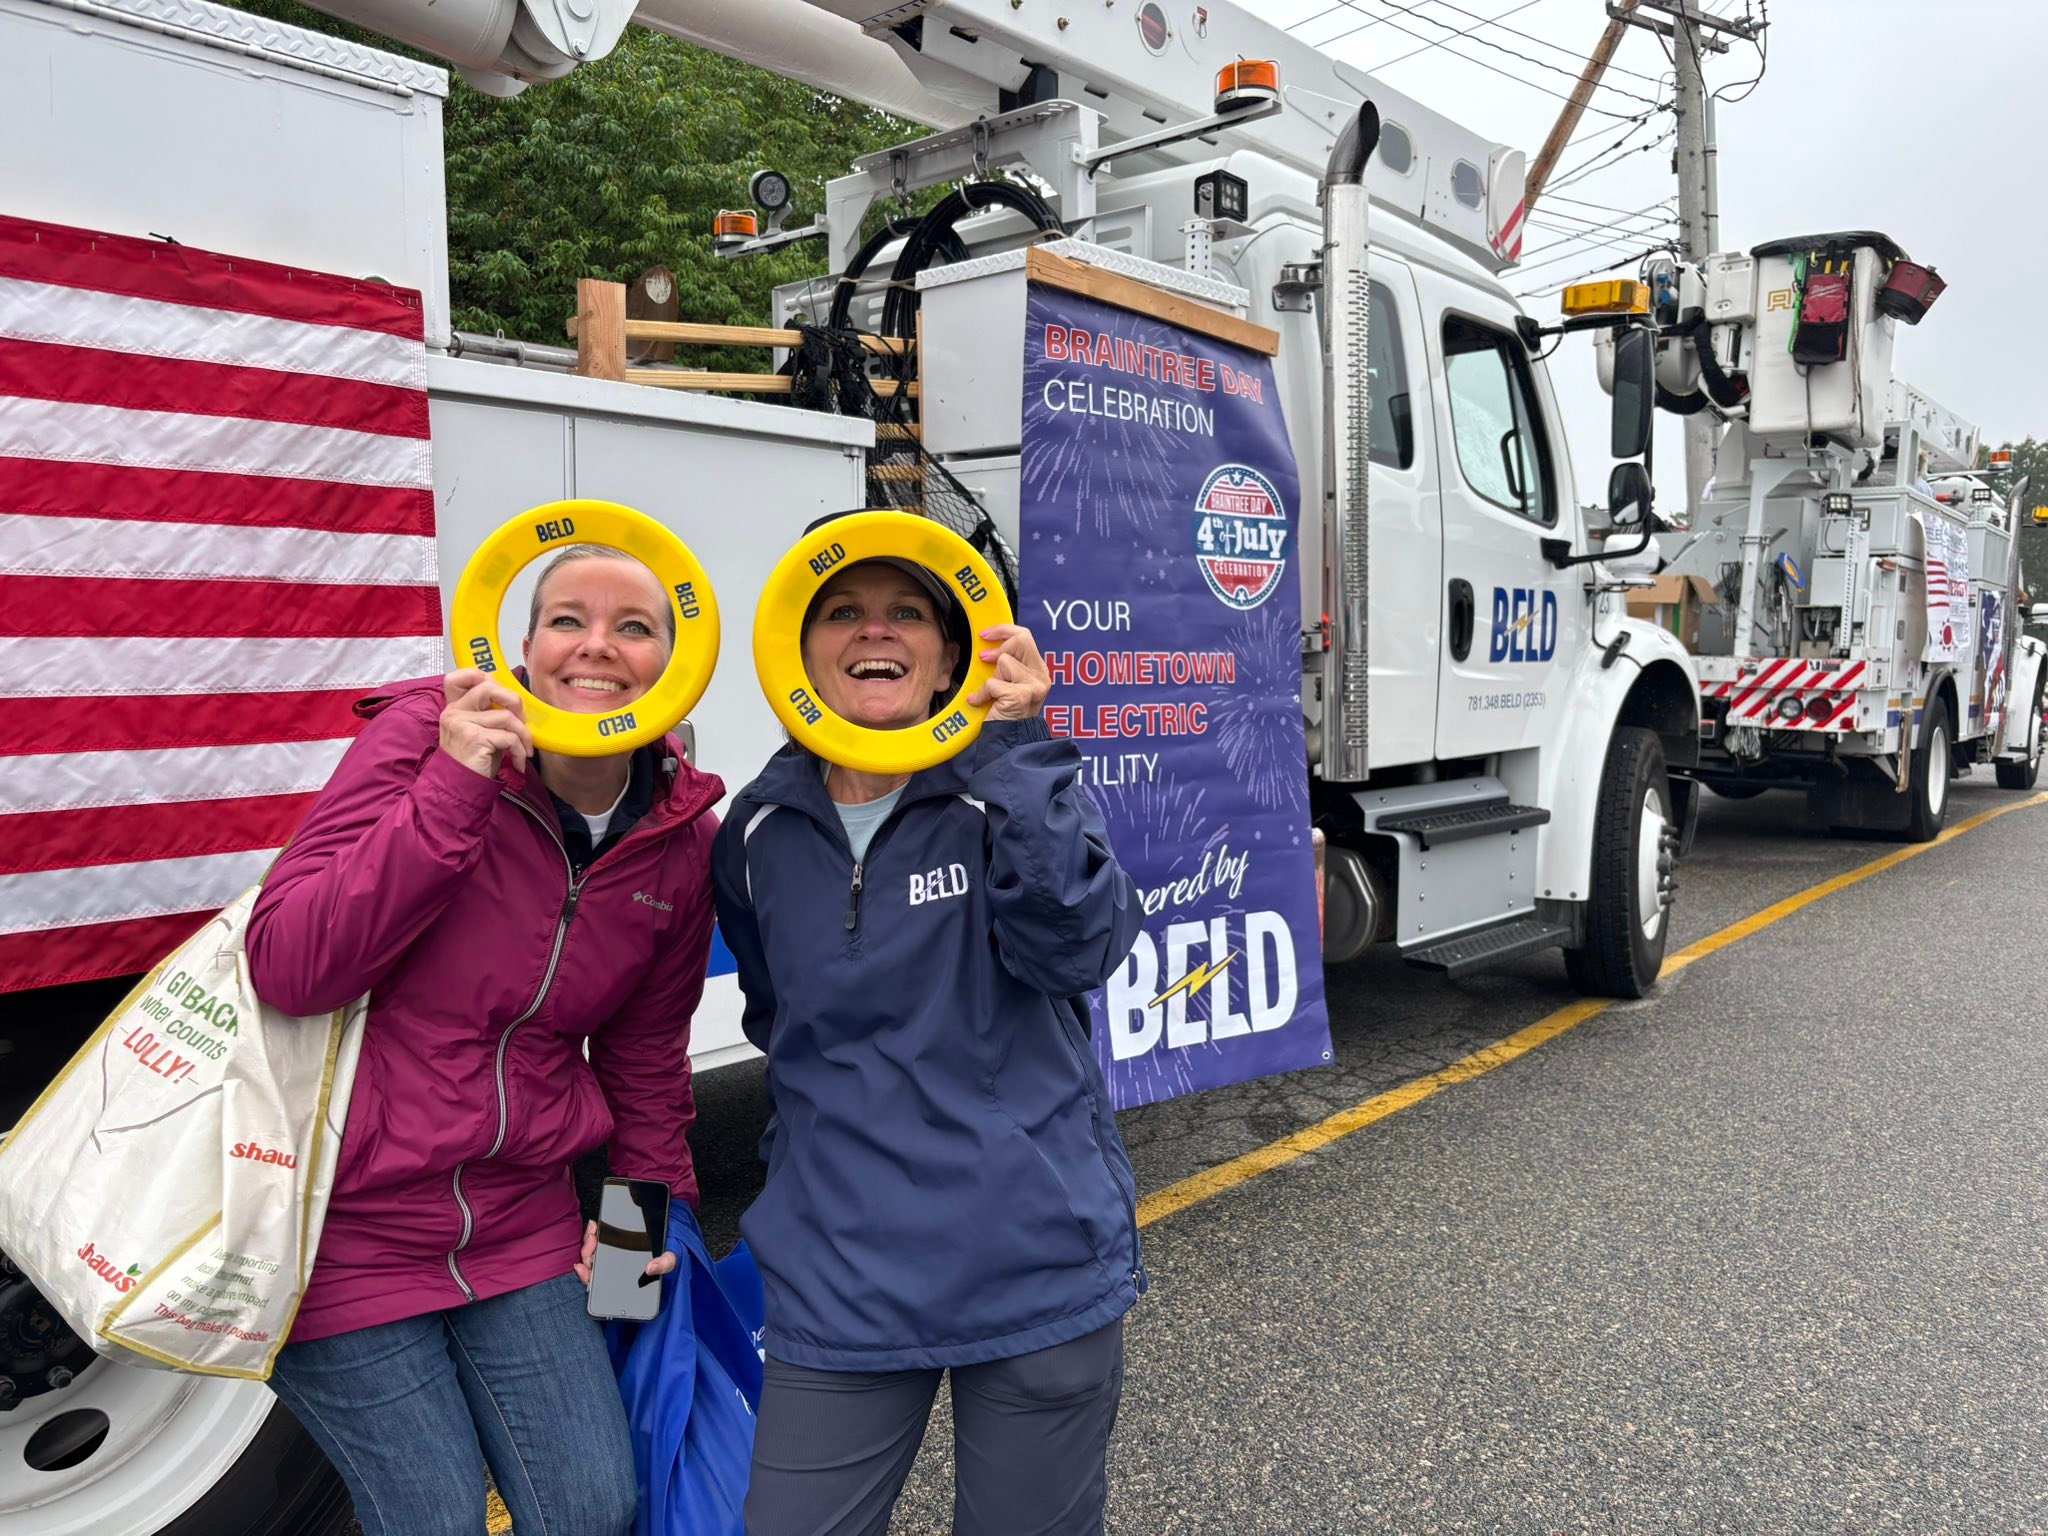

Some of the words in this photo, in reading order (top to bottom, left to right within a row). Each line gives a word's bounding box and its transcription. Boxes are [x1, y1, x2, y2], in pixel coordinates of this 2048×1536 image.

[1045, 324, 1216, 392] BRAINTREE
[1220, 364, 1263, 404] DAY
[1044, 379, 1214, 437] CELEBRATION
[1211, 493, 1249, 512] BRAINTREE
[1250, 497, 1268, 514] DAY
[536, 518, 576, 543] BELD
[1219, 523, 1236, 554] of
[1233, 520, 1287, 558] July
[808, 542, 847, 577] BELD
[1214, 562, 1268, 577] CELEBRATION
[674, 581, 701, 620] BELD
[954, 565, 988, 604] BELD
[1043, 600, 1131, 632] YOUR
[1489, 587, 1557, 663] BELD
[470, 637, 497, 673] BELD
[1045, 651, 1236, 685] HOMETOWN
[792, 687, 824, 726] BELD
[1044, 702, 1208, 739] ELECTRIC
[1467, 695, 1522, 711] 781.348.BELD
[597, 712, 637, 737] BELD
[932, 710, 969, 743] BELD
[1078, 753, 1159, 786] TILITY
[909, 863, 969, 906] BELD
[1136, 851, 1212, 915] ered
[1214, 844, 1250, 900] by
[1106, 910, 1298, 1061] BELD
[166, 1019, 228, 1061] counts
[229, 1142, 298, 1170] shaw
[166, 1289, 182, 1303] on
[179, 1298, 198, 1312] my
[180, 1275, 208, 1295] make
[238, 1290, 270, 1309] impact
[153, 1302, 178, 1321] This
[175, 1314, 196, 1331] bag
[195, 1321, 226, 1334] makes
